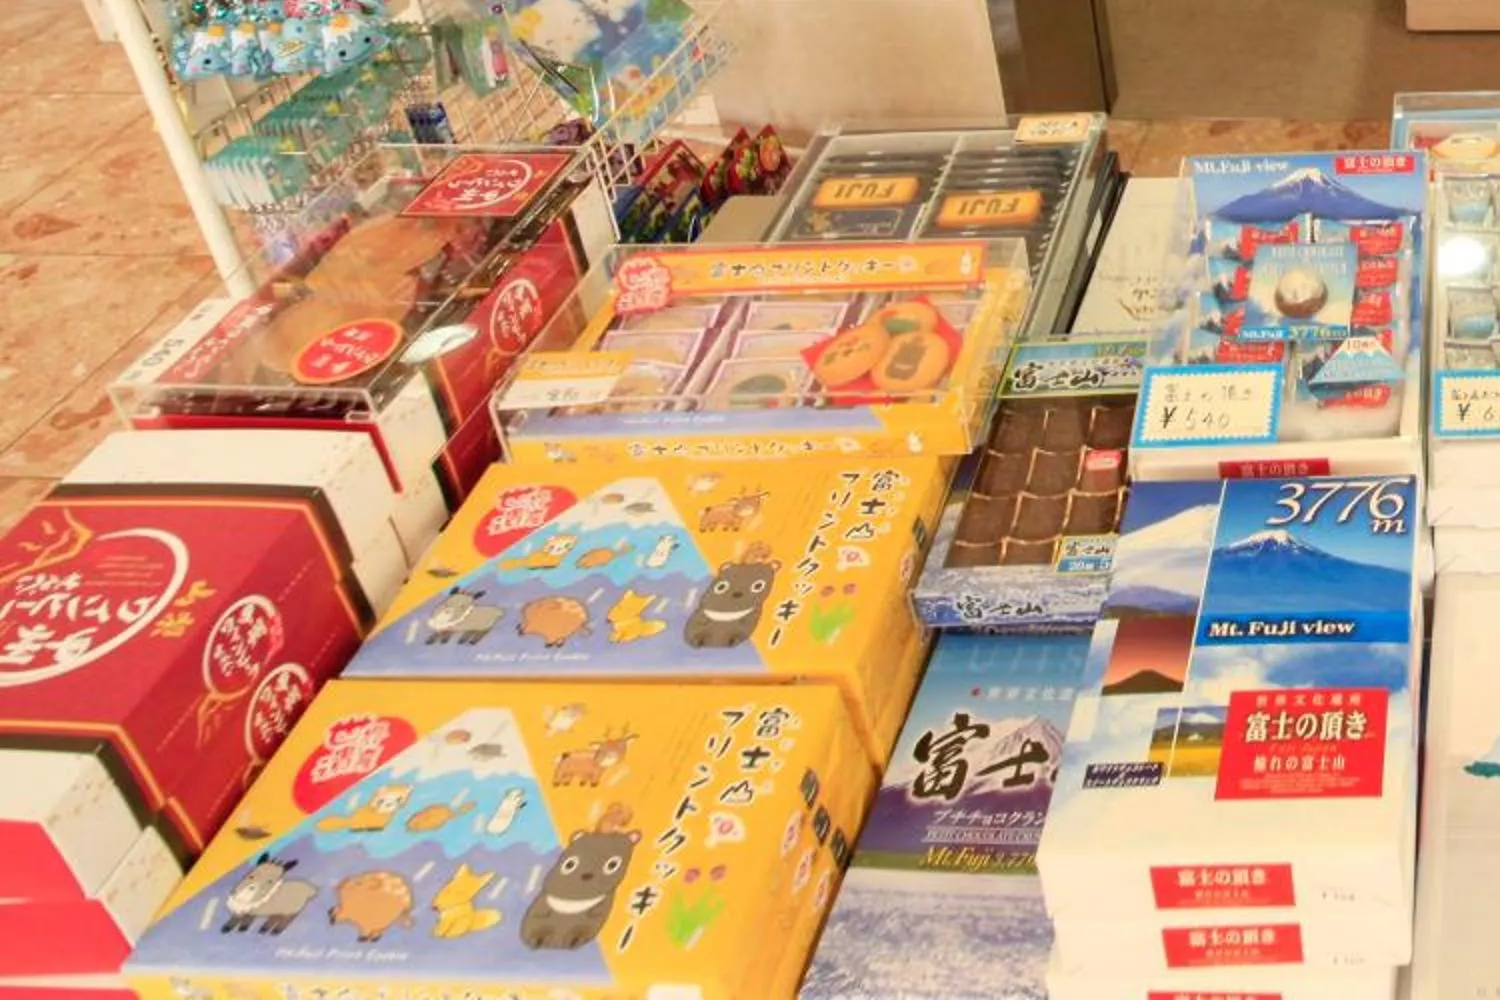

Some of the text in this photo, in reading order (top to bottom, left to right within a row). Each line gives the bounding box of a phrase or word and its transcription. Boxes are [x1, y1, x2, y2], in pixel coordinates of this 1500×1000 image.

[834, 183, 897, 199] FUJI
[959, 201, 1021, 217] FUJI
[1186, 407, 1230, 430] 540
[845, 470, 900, 538] 富士山
[1265, 478, 1410, 525] 3776
[1371, 518, 1407, 533] m
[956, 595, 1044, 620] 富士山
[1208, 619, 1355, 637] Mt. Fuji view
[1244, 710, 1370, 743] 富士の頂き
[719, 707, 790, 802] 富士山
[912, 712, 1060, 801] 富士
[1252, 754, 1347, 774] 憧れの富士山
[1177, 868, 1266, 888] 富士の頂き
[1188, 928, 1277, 948] 富士の頂き
